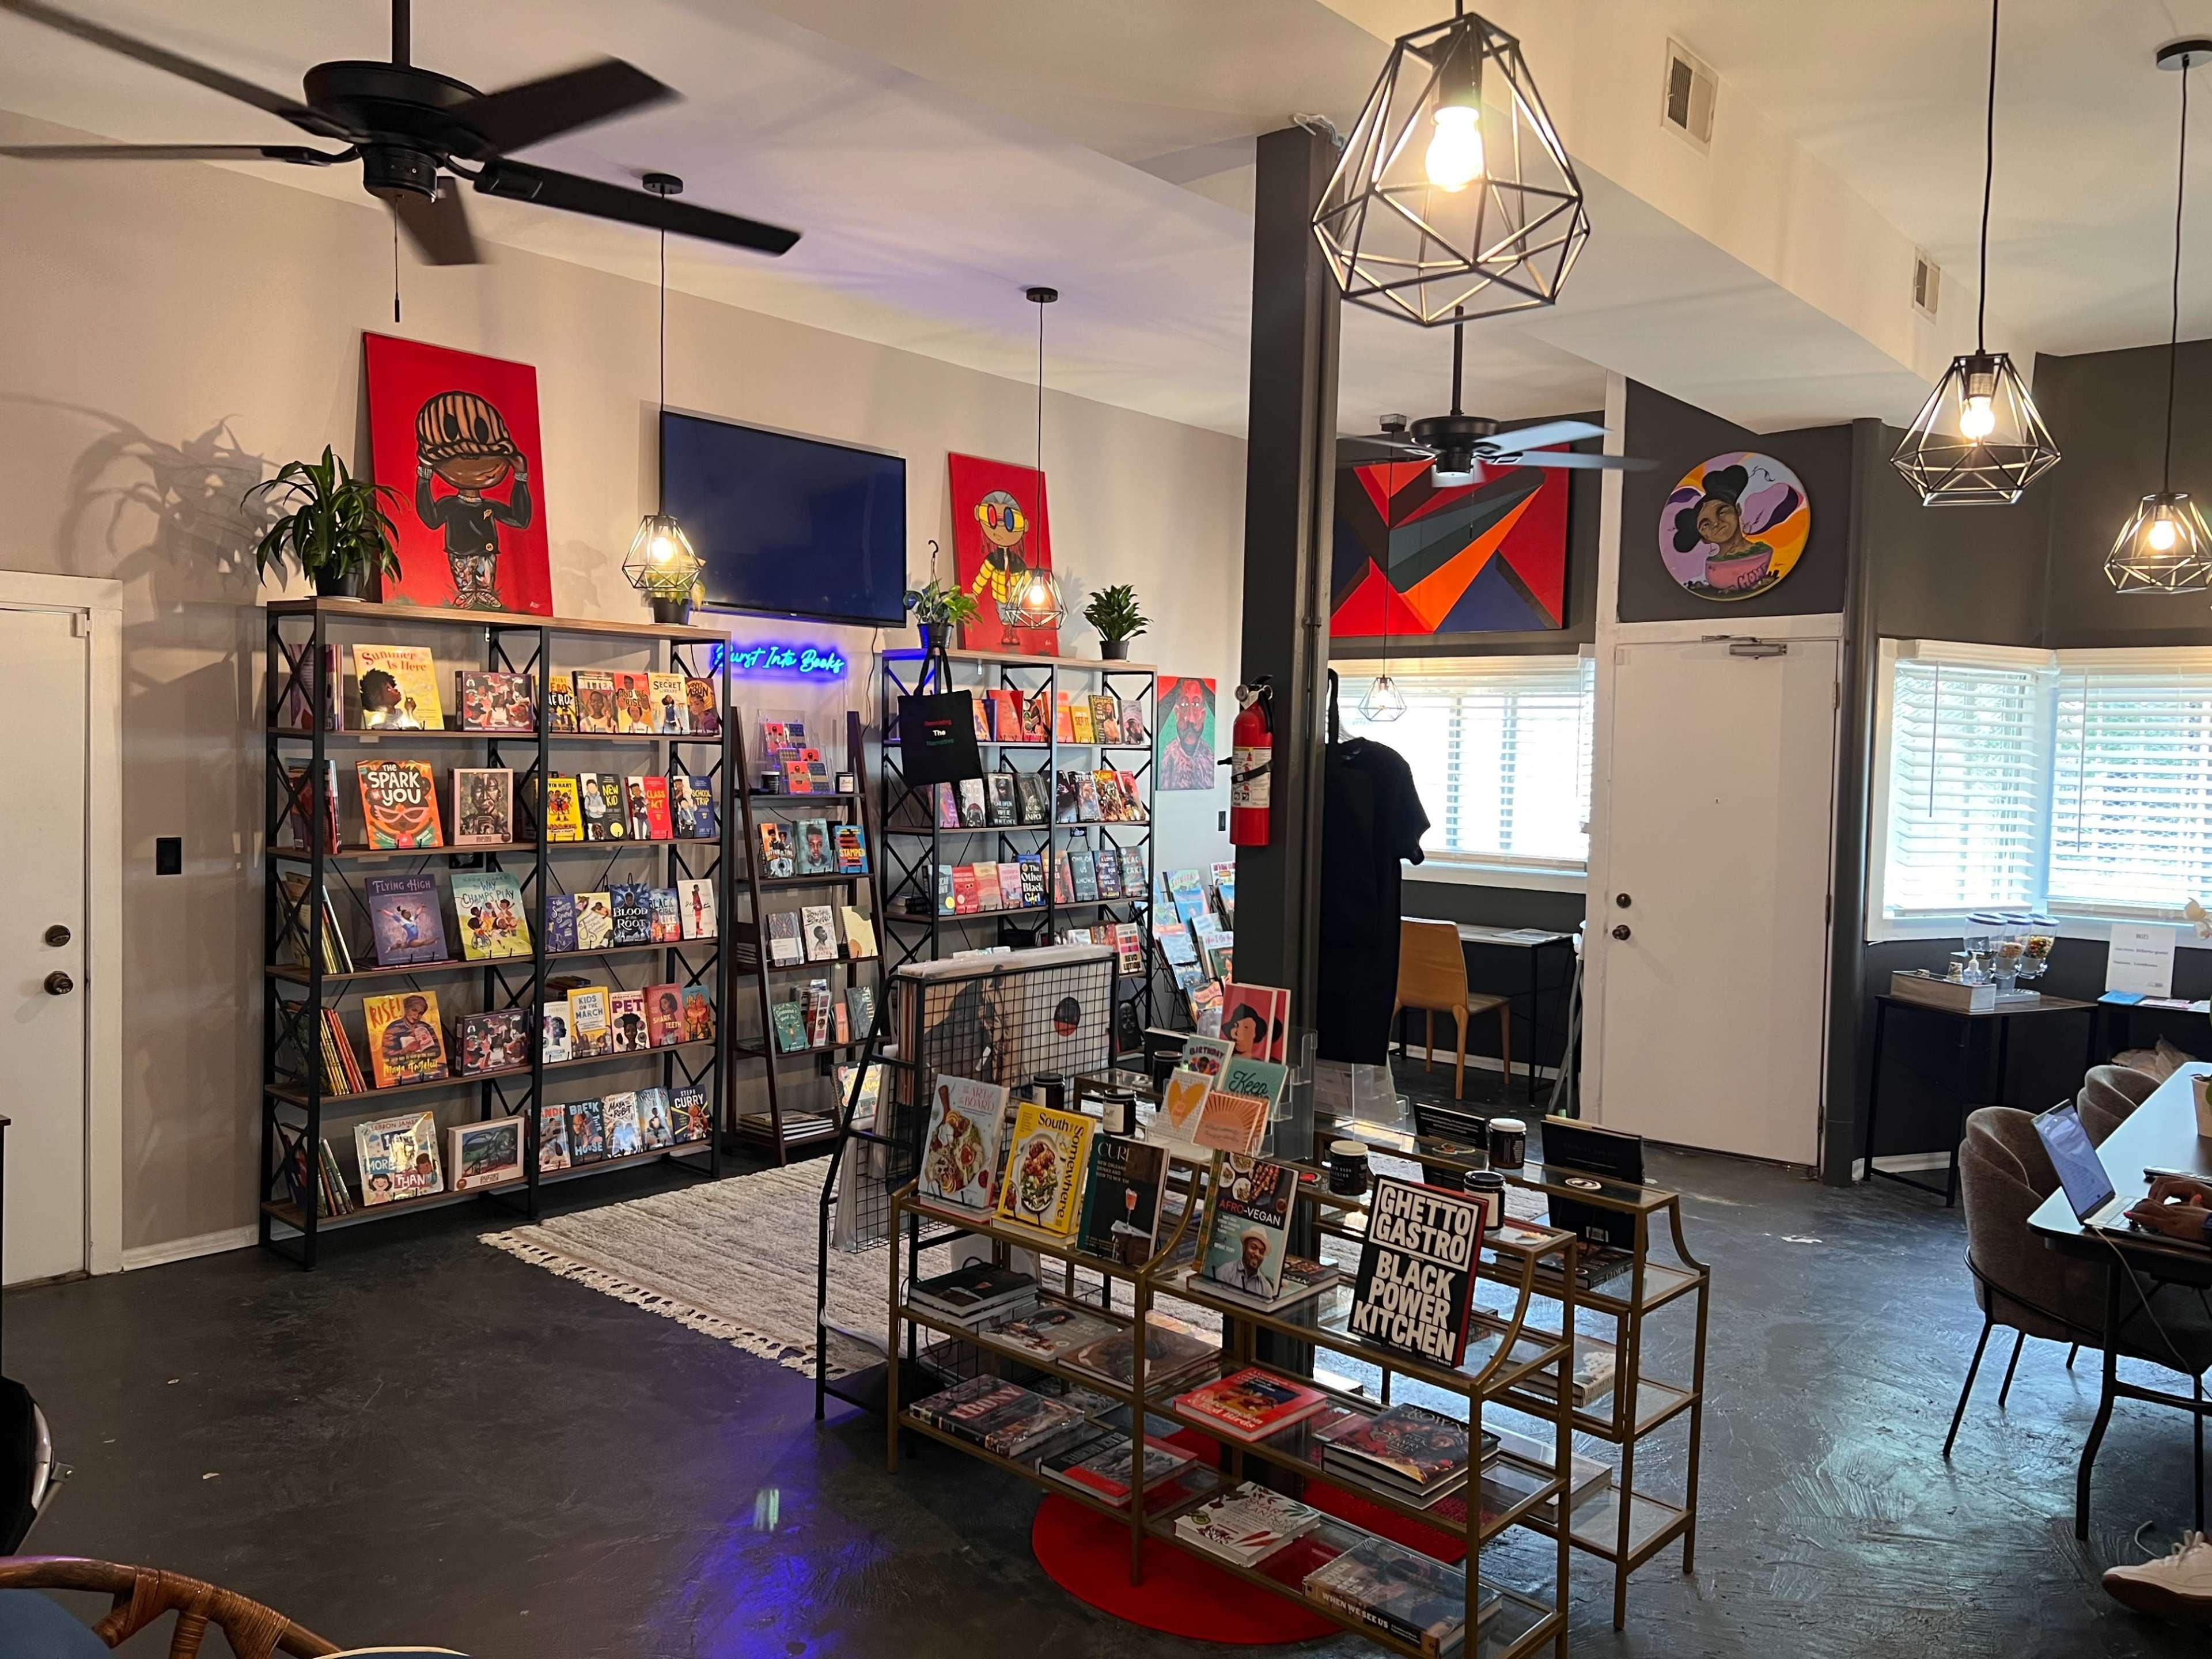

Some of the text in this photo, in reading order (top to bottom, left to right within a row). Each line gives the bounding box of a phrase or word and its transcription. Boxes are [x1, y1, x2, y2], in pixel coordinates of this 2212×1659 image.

[362, 651, 415, 665] Summer
[762, 646, 796, 668] Into
[800, 649, 844, 673] Books
[387, 660, 426, 671] Is Here
[577, 680, 613, 690] BITTER
[654, 681, 681, 691] SECRET
[687, 685, 709, 697] MOON
[368, 771, 420, 789] SPARK
[602, 785, 618, 796] NEW
[646, 790, 665, 798] CLASS
[382, 789, 421, 806] YOU
[605, 795, 618, 806] KID
[695, 797, 709, 806] TRIP
[651, 800, 663, 809] ACT
[839, 848, 866, 857] STAMPED
[1021, 872, 1042, 881] Other
[373, 880, 431, 893] FLYING HIGH
[480, 880, 496, 891] WAY
[1022, 882, 1043, 892] Black
[463, 892, 494, 904] CHAMPS
[650, 898, 673, 908] BLACK
[613, 908, 647, 916] BLOOD
[617, 919, 646, 930] ROOT
[661, 915, 676, 924] LIKE
[666, 924, 676, 933] ME
[578, 995, 596, 1004] KIDS
[612, 999, 643, 1013] PET
[370, 997, 402, 1028] RISE!
[576, 1009, 603, 1018] MARCH
[653, 1014, 672, 1024] SHARK
[1190, 1047, 1224, 1059] BIRTHDAY
[384, 1059, 437, 1077] Maya Angelou
[608, 1101, 626, 1112] MAYA
[675, 1094, 703, 1108] CURRY
[614, 1105, 632, 1118] ROBOT
[372, 1120, 397, 1131] LEBRON
[1039, 1112, 1069, 1132] South
[575, 1143, 603, 1156] HOUSE
[368, 1159, 396, 1171] MORE
[1057, 1126, 1084, 1218] Somewhere
[397, 1173, 425, 1189] THAN
[1219, 1199, 1281, 1226] AFRO-VEGAN
[1381, 1187, 1471, 1236] GHETTO
[1376, 1213, 1465, 1263] GASTRO
[1376, 1250, 1455, 1301] BLACK
[1368, 1276, 1450, 1330] POWER
[1353, 1300, 1456, 1361] KITCHEN
[949, 1387, 1022, 1419] EBONY
[1322, 1593, 1388, 1629] WHEN WE SEE US
